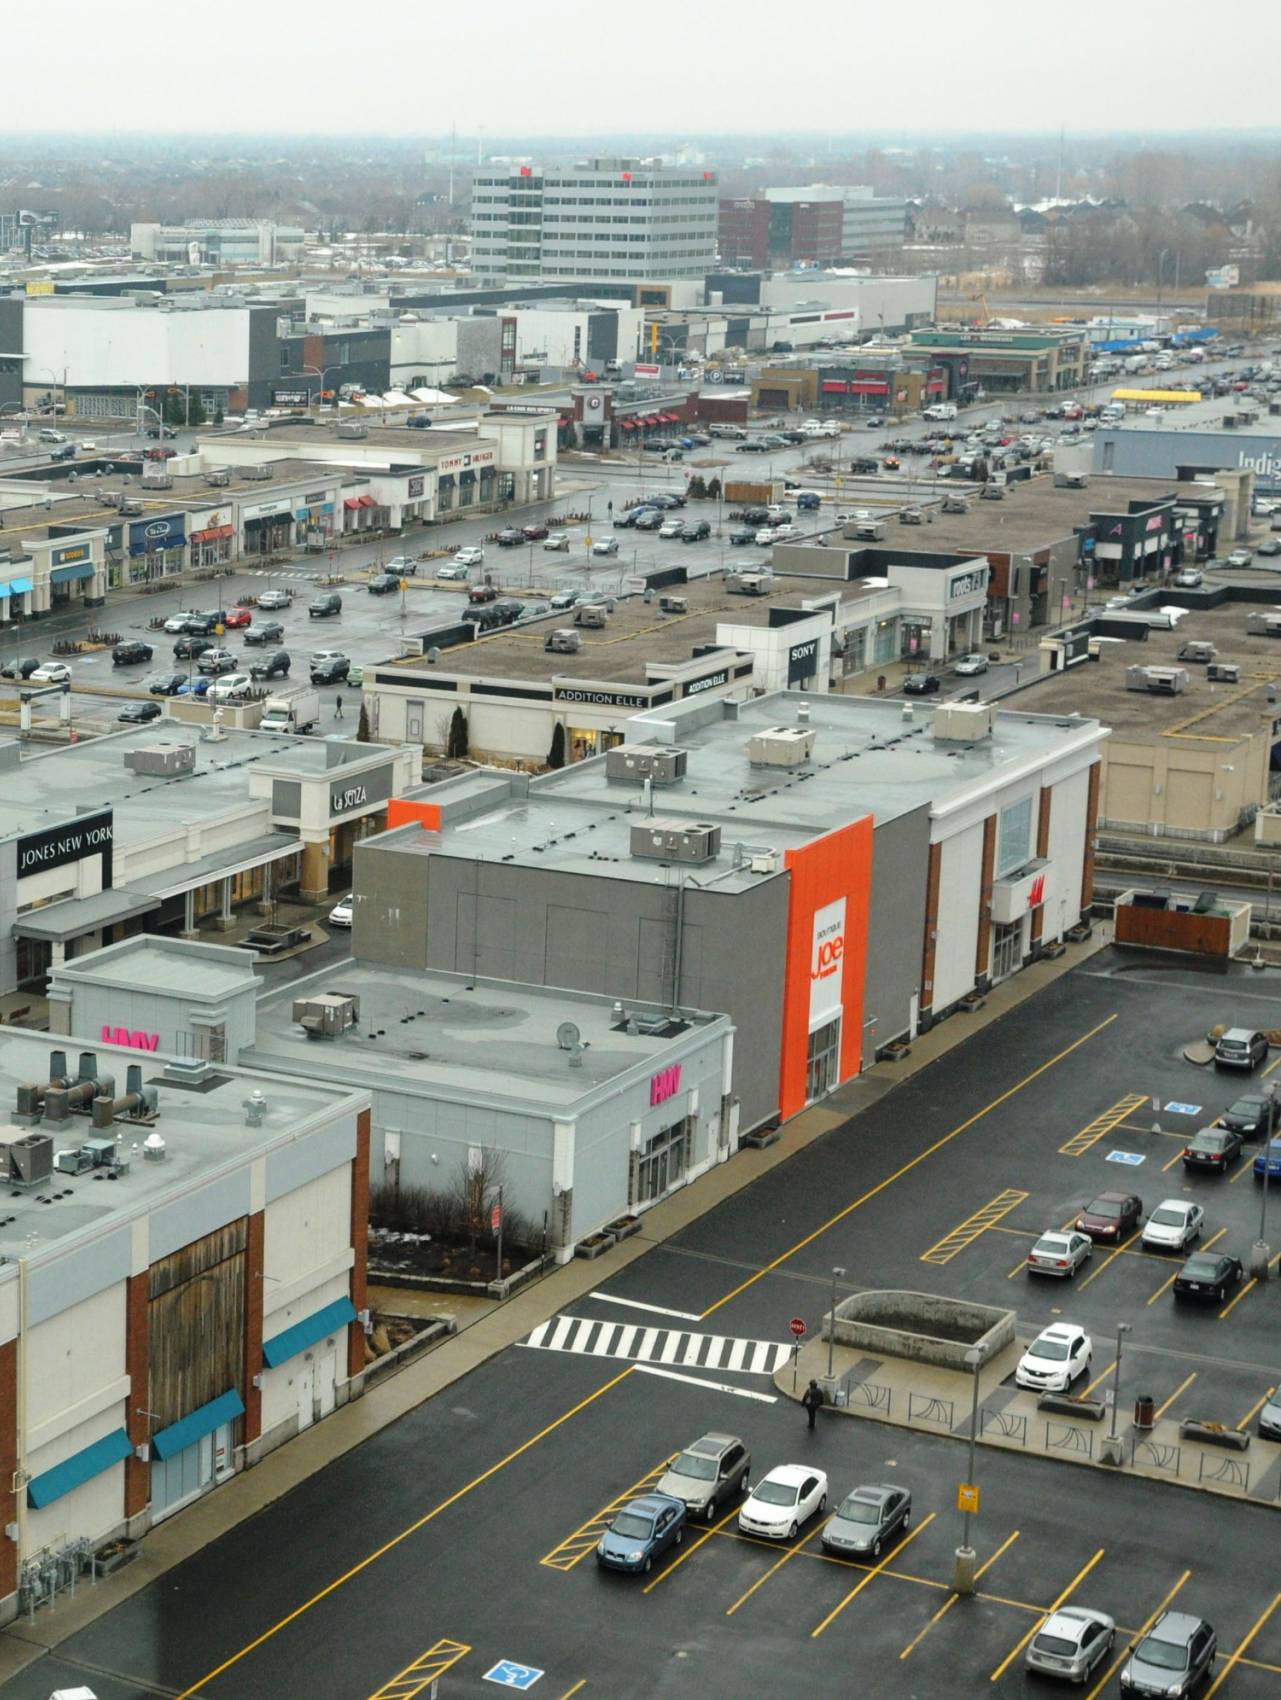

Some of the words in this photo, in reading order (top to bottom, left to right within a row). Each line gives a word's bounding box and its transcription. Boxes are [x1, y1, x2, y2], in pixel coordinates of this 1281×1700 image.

[441, 459, 462, 469] TOMMY
[792, 643, 816, 661] SONY
[688, 678, 713, 693] ADDITION
[713, 674, 725, 686] ELLE
[558, 690, 613, 704] ADDITION
[616, 695, 644, 707] ELLE
[21, 843, 56, 869] JONES
[57, 835, 83, 855] NEW
[86, 826, 113, 846] YORK
[650, 1064, 682, 1106] HMV
